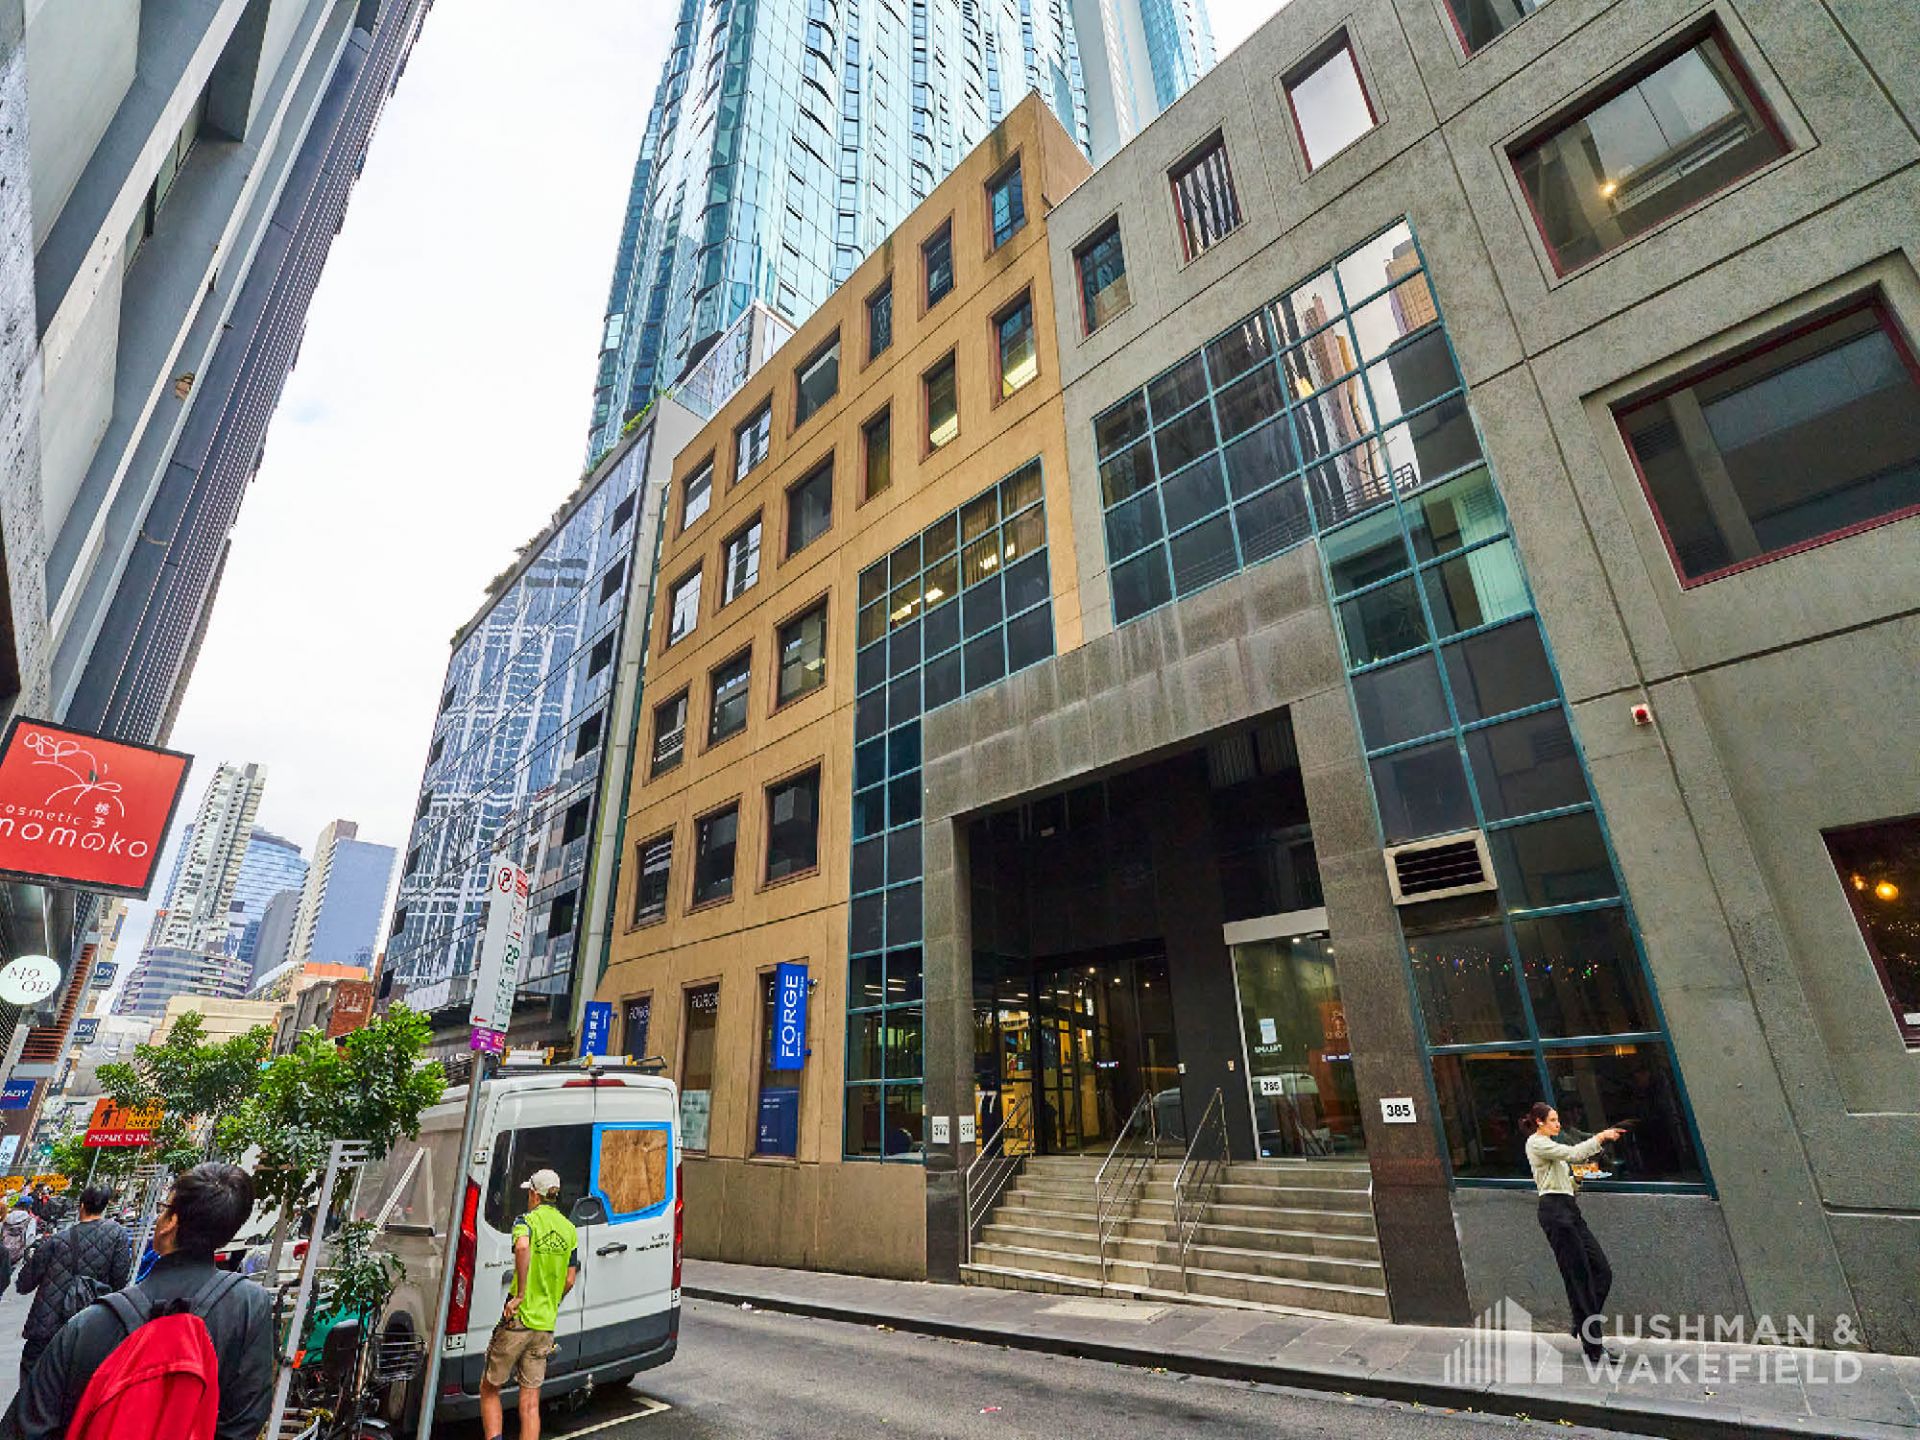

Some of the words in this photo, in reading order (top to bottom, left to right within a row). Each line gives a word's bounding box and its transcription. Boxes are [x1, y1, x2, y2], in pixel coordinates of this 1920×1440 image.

[0, 803, 85, 827] osmetic
[781, 975, 799, 1057] FORGE
[1263, 1081, 1280, 1091] 385
[1, 1089, 29, 1097] ADY
[1386, 1104, 1411, 1117] 385
[88, 1133, 123, 1143] PREPARE
